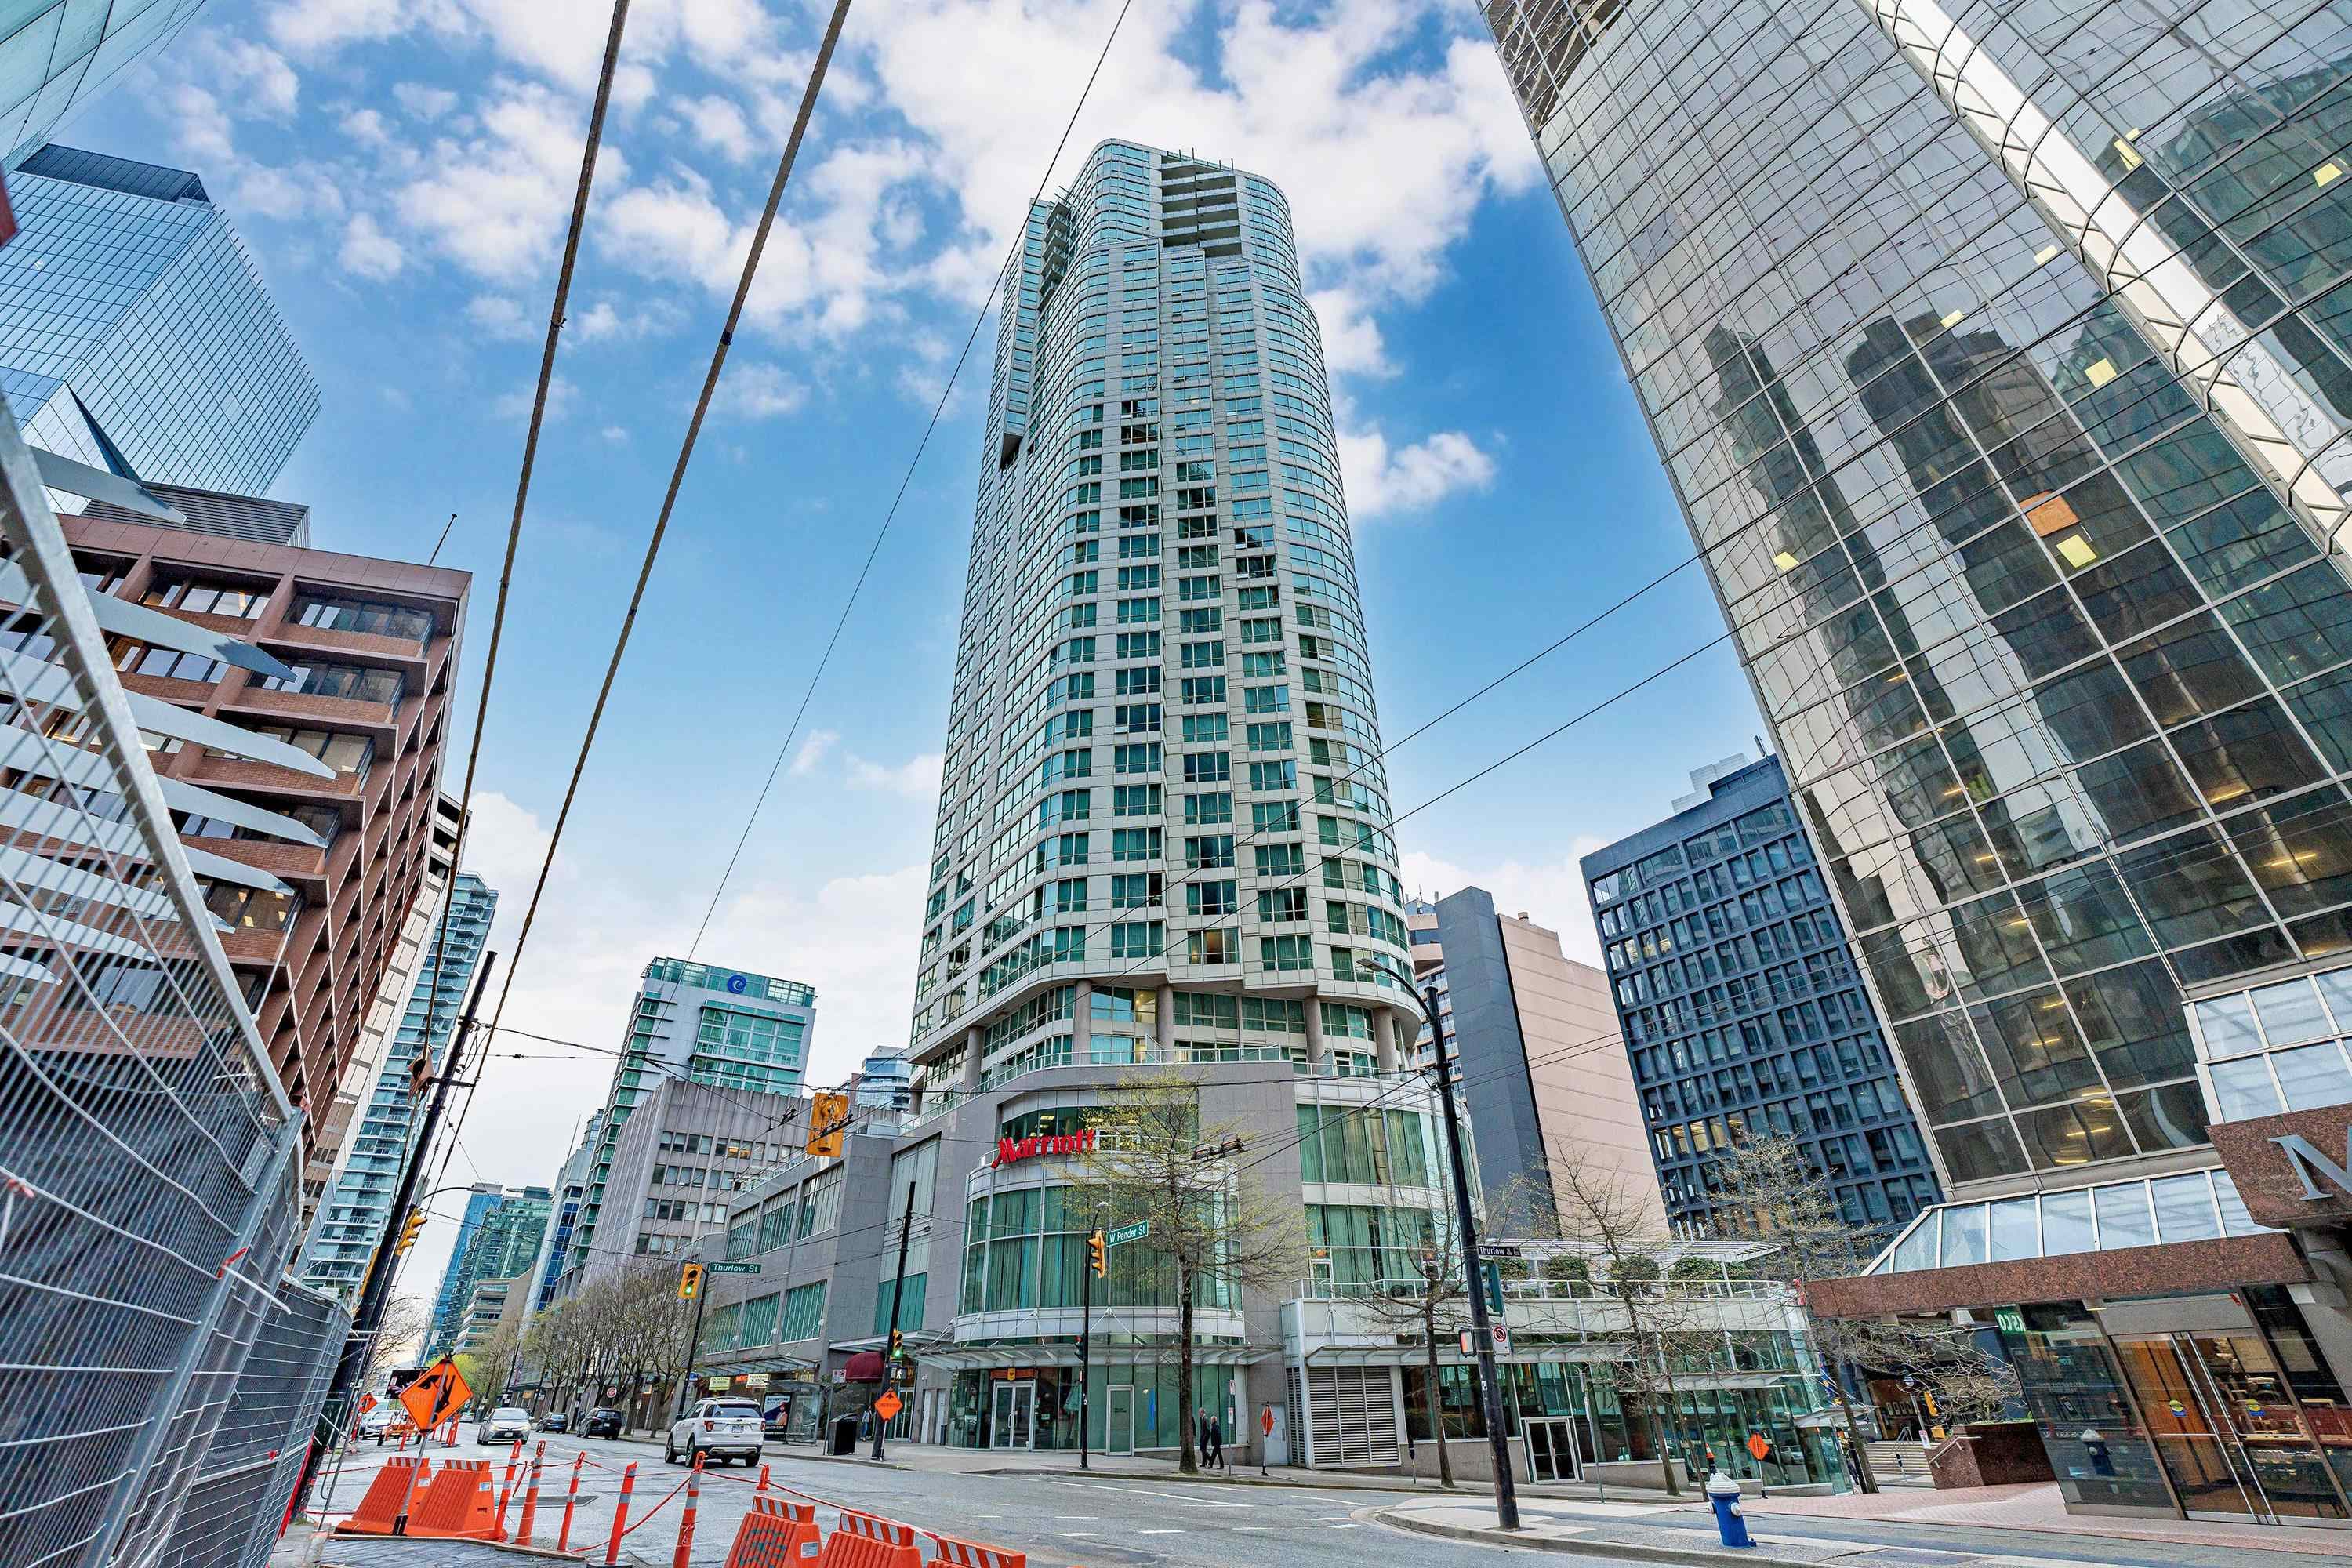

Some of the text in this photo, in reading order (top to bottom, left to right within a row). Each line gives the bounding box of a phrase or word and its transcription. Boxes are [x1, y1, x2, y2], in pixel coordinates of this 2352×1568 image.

[991, 1128, 1094, 1169] Marriott
[1109, 1225, 1145, 1243] W Pender St
[1479, 1246, 1504, 1255] Thurlow
[713, 1263, 758, 1273] Thurlow St
